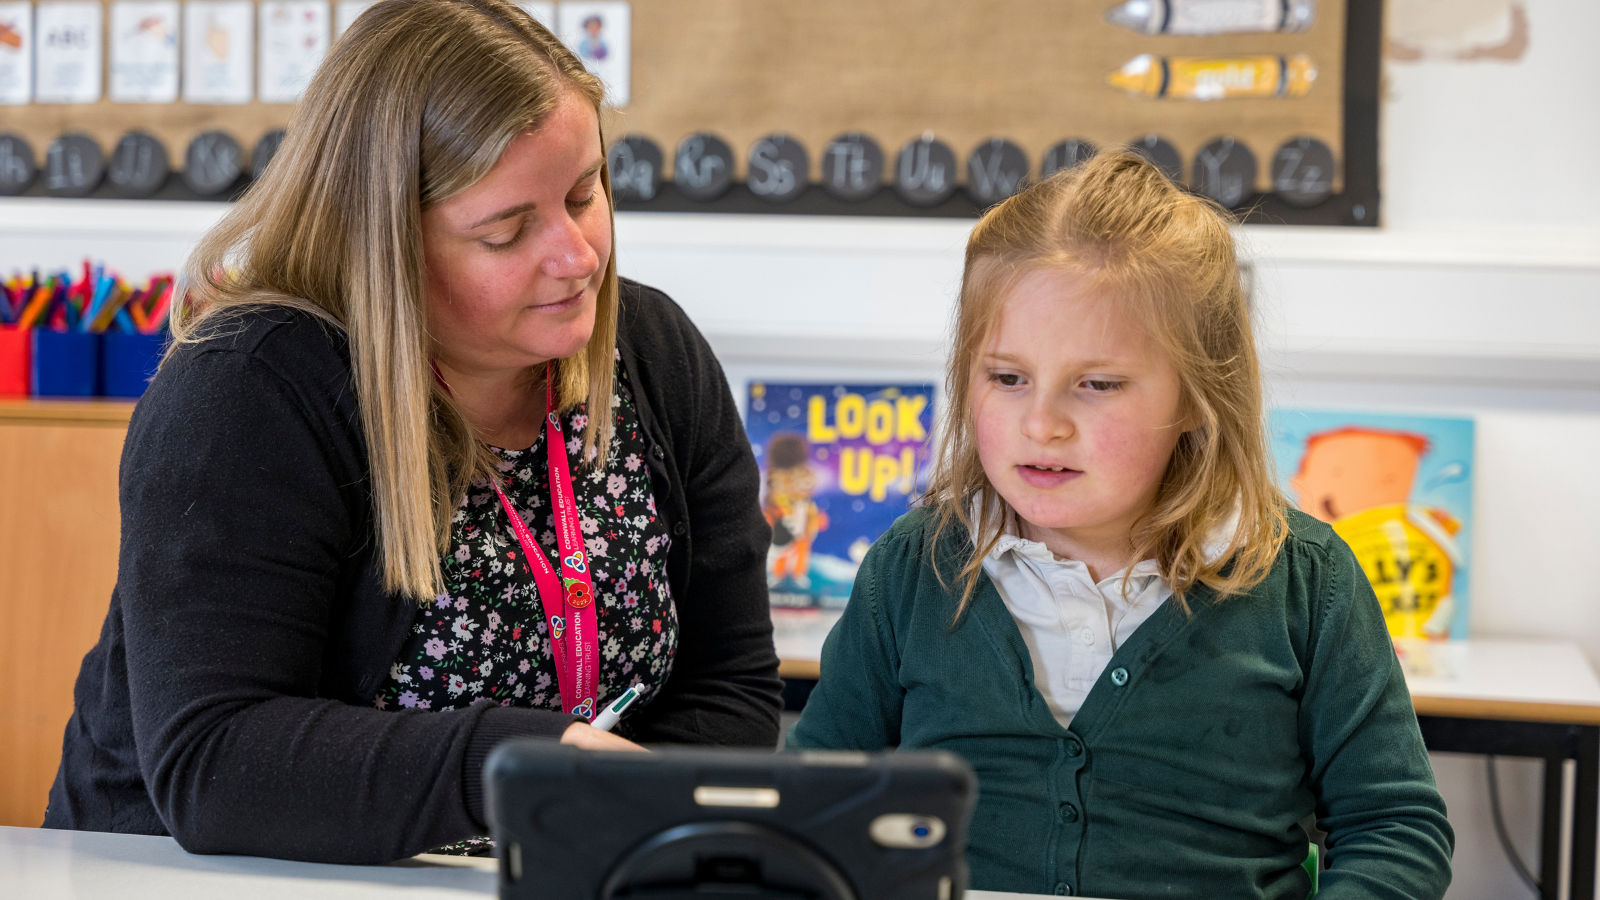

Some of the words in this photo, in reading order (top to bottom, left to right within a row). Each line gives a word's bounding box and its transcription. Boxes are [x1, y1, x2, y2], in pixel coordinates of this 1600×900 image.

[675, 134, 725, 188] Rr
[749, 139, 795, 196] Ss
[829, 141, 871, 190] Tt
[900, 136, 946, 192] Uu
[1277, 147, 1327, 194] Zz
[807, 393, 928, 445] LOOK
[554, 467, 565, 508] EDUCATION
[565, 496, 573, 516] TRUST
[560, 510, 571, 550] CORNWALL
[568, 517, 579, 550] LEARNING
[525, 533, 549, 575] EDUCATION
[574, 611, 582, 657] EDUCATION
[584, 641, 592, 662] TRUST
[575, 658, 583, 699] CORNWALL
[584, 665, 592, 698] LEARNING
